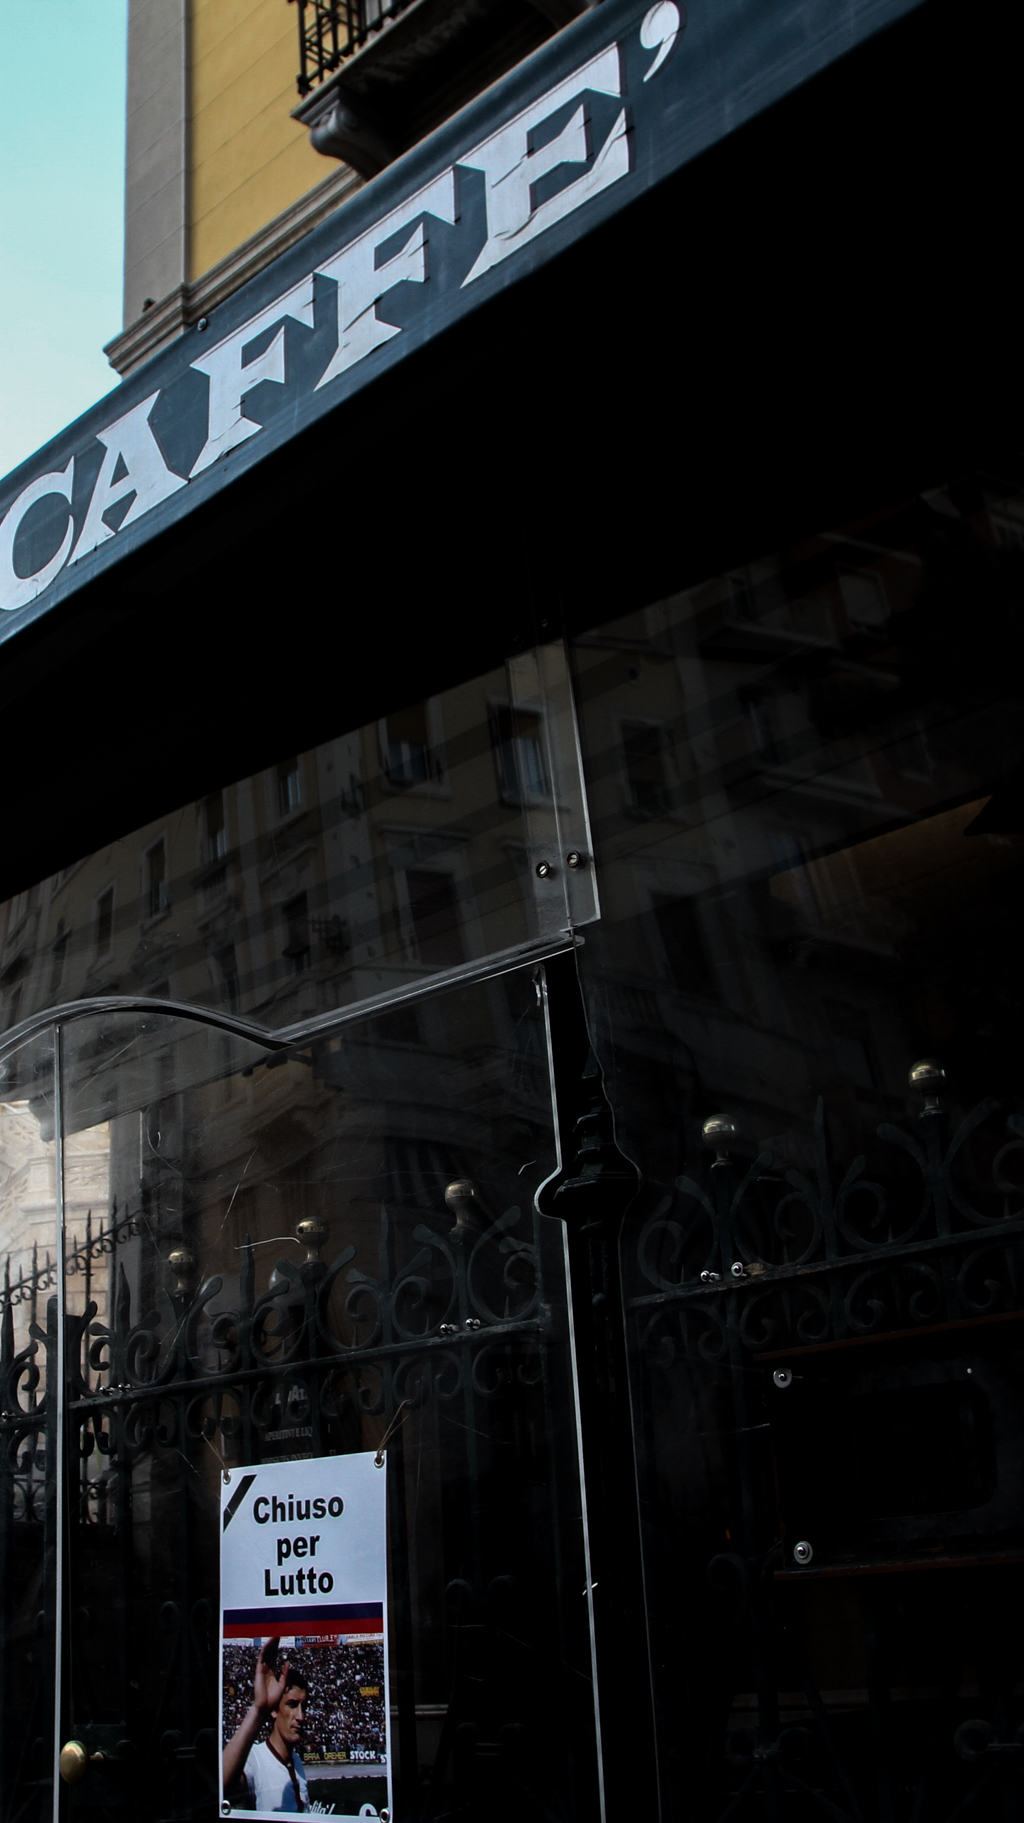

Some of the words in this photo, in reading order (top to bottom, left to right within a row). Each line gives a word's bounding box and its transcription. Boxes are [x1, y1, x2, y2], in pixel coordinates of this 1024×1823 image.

[253, 1493, 344, 1524] Chiuso
[276, 1534, 321, 1567] per
[264, 1566, 334, 1597] Lutto
[303, 1752, 321, 1761] BIRRA
[323, 1751, 347, 1761] DREHER
[349, 1750, 377, 1760] STOCK
